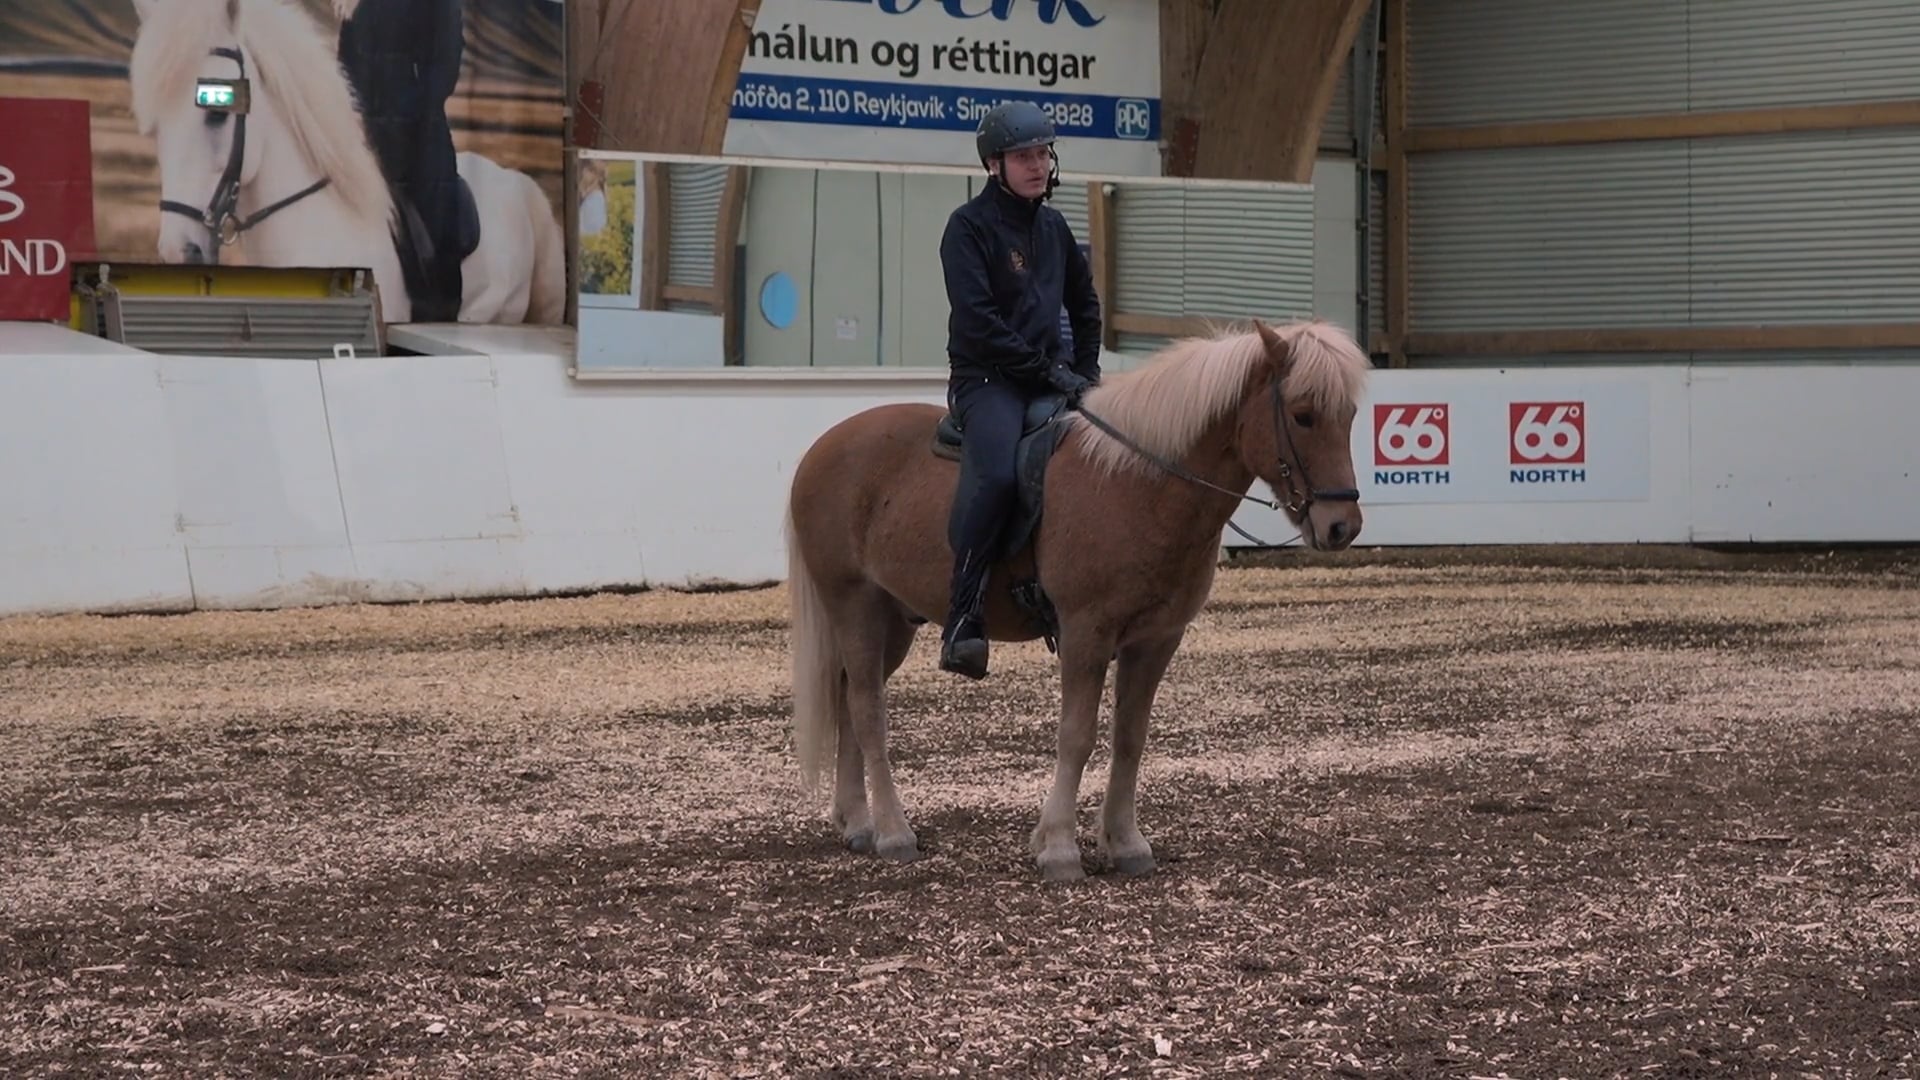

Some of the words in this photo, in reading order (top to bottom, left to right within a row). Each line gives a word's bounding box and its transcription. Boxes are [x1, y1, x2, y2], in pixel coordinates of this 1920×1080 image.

[871, 40, 919, 78] og
[932, 37, 1096, 87] réttingar
[796, 87, 815, 114] 2,
[818, 88, 850, 113] 110
[1043, 103, 1093, 127] 2828
[1117, 103, 1148, 134] PPG
[0, 239, 66, 276] ND
[1374, 470, 1450, 484] NORTH
[1510, 469, 1586, 483] NORTH
